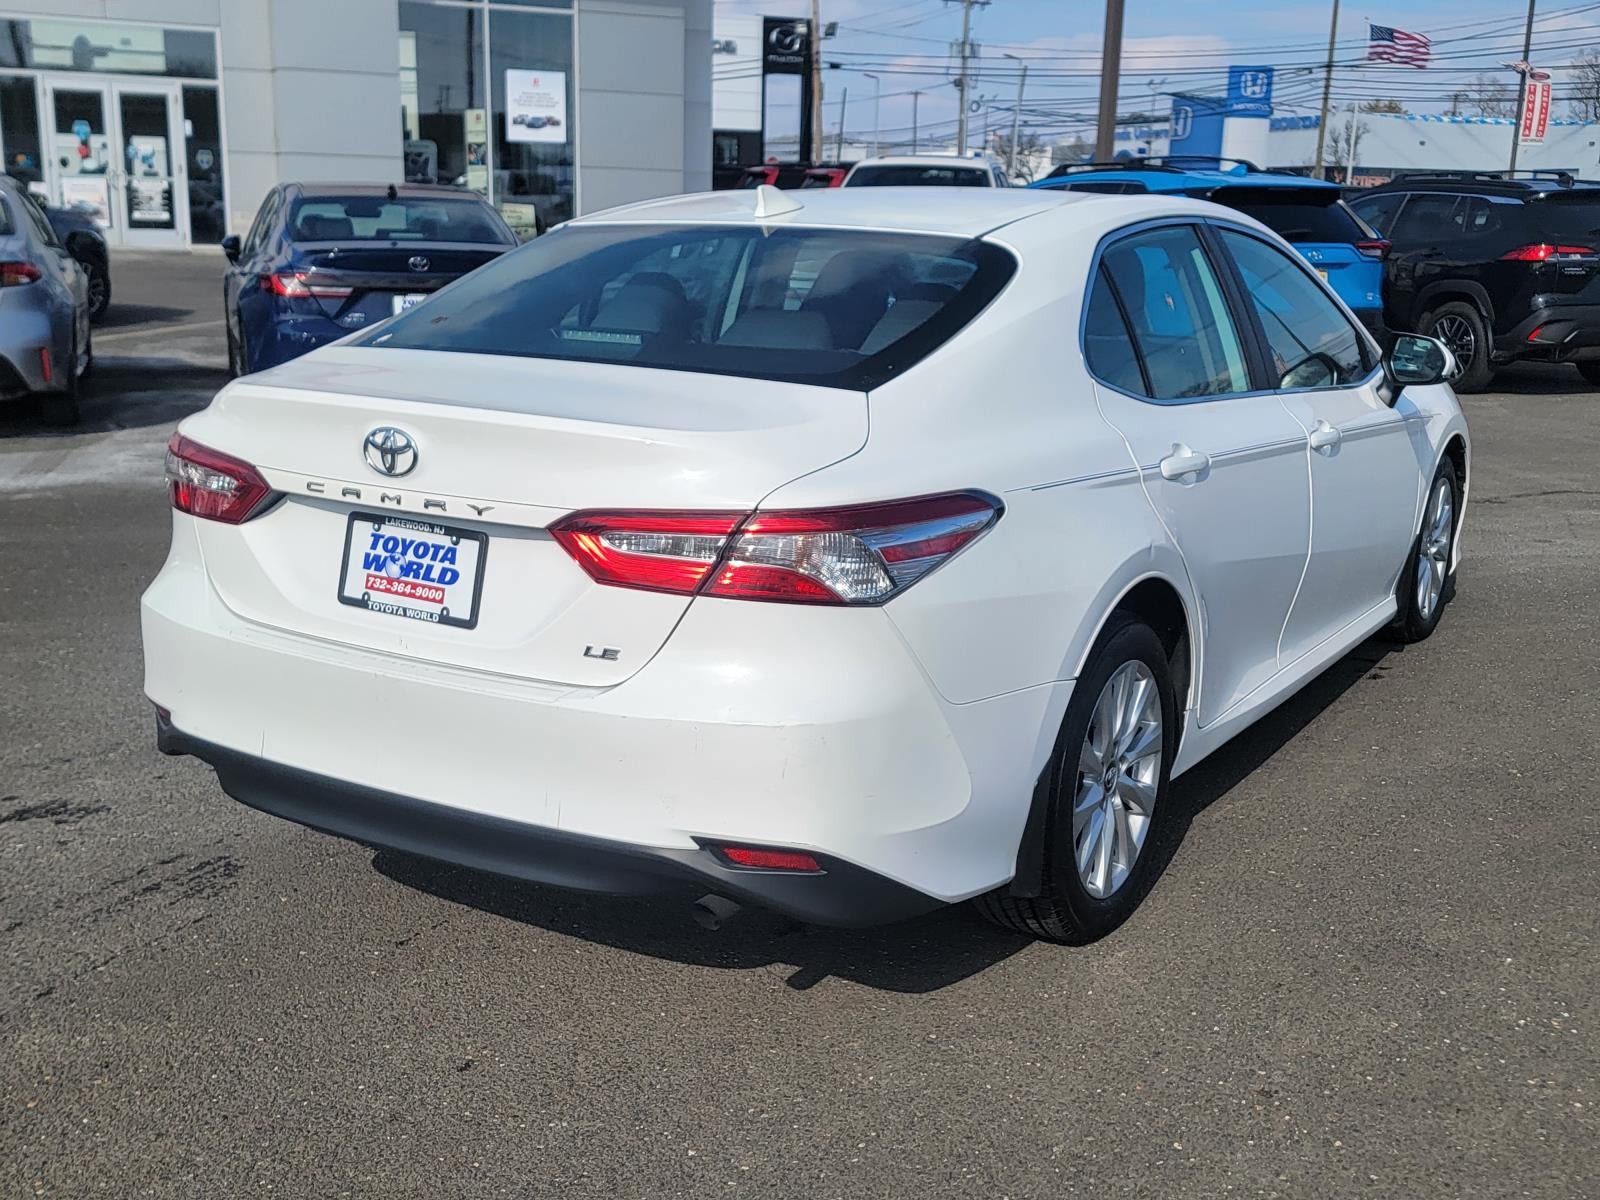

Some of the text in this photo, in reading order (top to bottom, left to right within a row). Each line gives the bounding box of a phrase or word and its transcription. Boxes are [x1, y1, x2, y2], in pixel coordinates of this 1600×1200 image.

[1523, 85, 1536, 135] TOYOTA
[306, 481, 495, 516] CAMRY
[433, 526, 445, 534] NJ
[369, 532, 458, 565] TOYOTA
[367, 577, 443, 600] 732-364-9000
[368, 601, 440, 622] TOYOTA WORLD
[583, 646, 621, 661] LE
